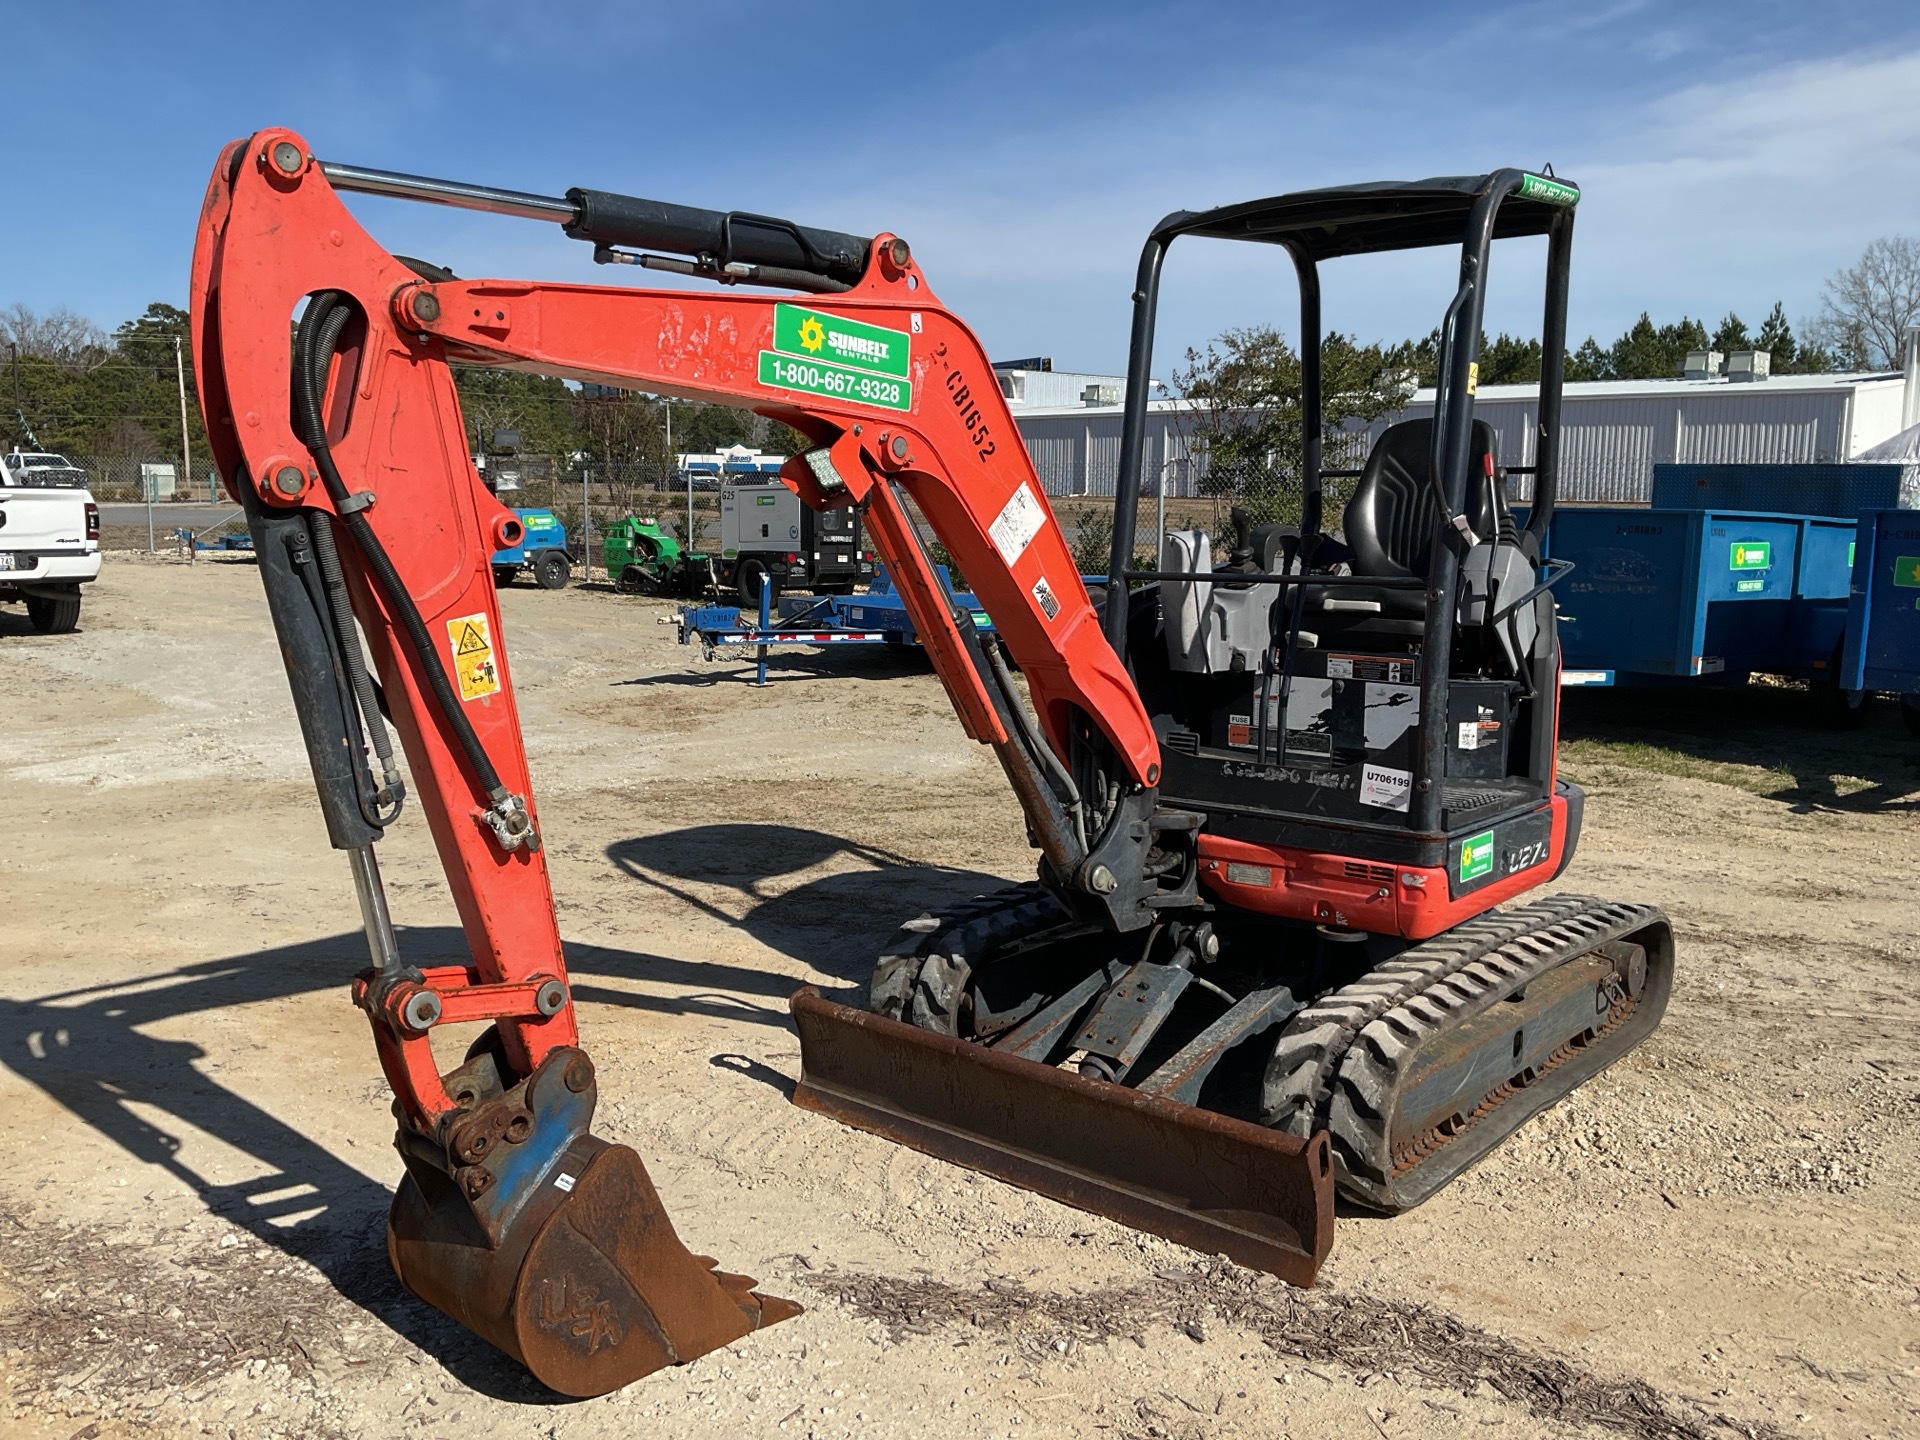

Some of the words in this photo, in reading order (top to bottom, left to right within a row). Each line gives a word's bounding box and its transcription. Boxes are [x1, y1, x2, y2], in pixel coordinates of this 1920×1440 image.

[828, 331, 889, 358] SUNBELT
[835, 346, 880, 363] RENTALS
[773, 360, 900, 403] 1-800-667-9328
[930, 342, 996, 463] 2-CB1652
[722, 491, 735, 500] G25
[1231, 716, 1248, 724] FUSE
[1367, 771, 1410, 787] U706199
